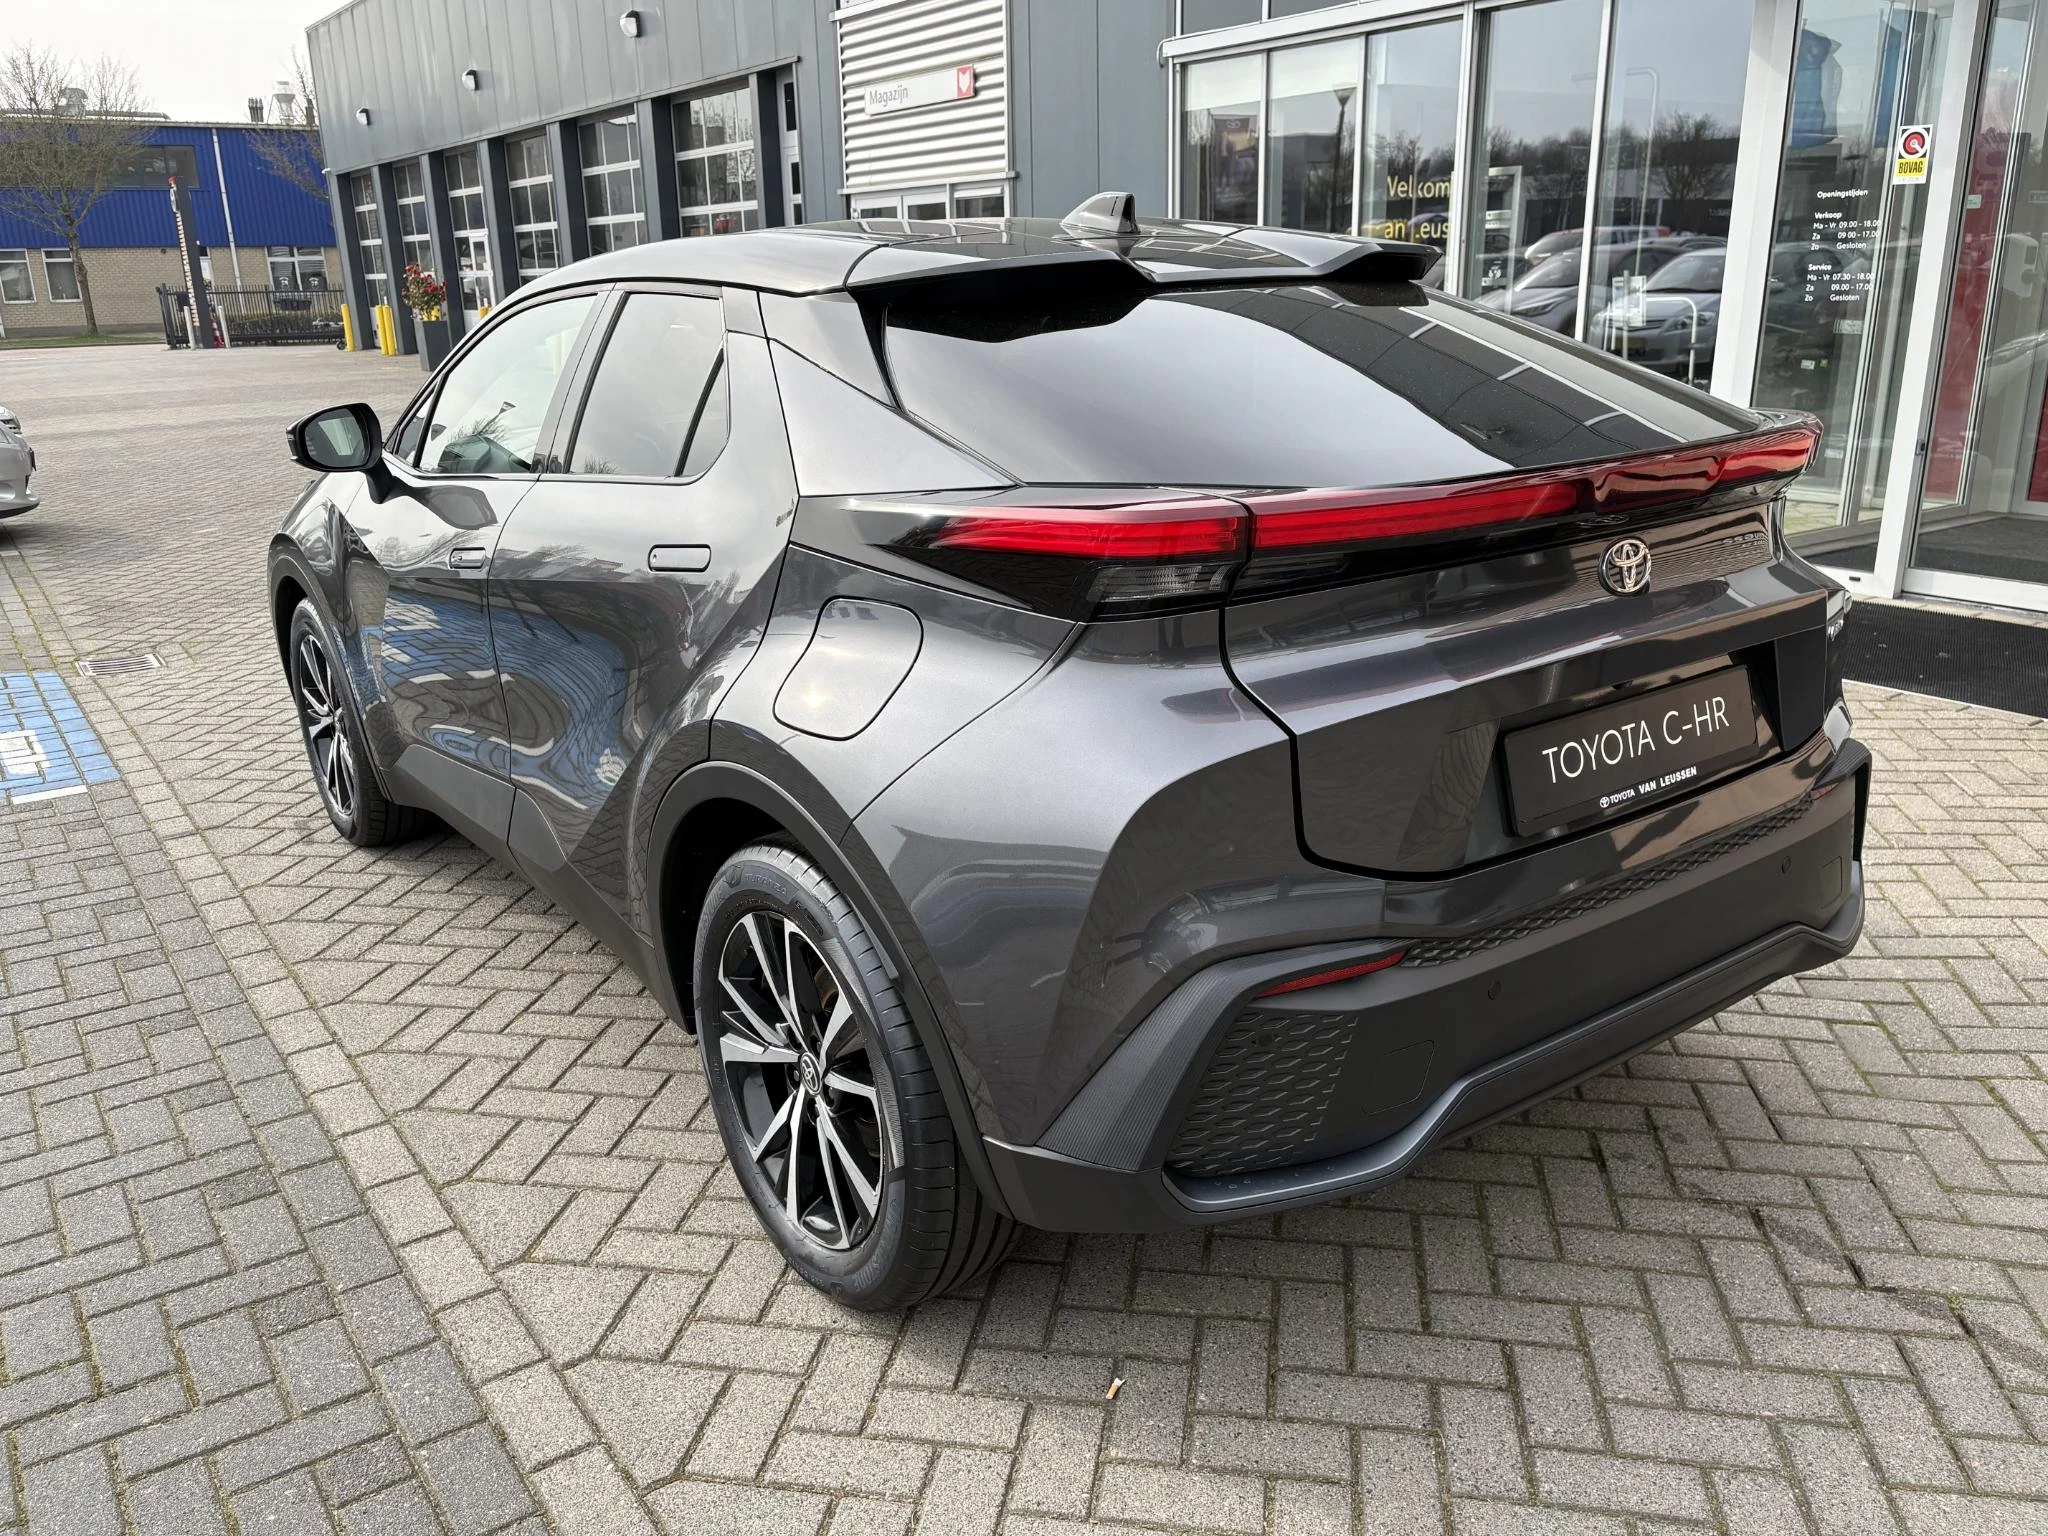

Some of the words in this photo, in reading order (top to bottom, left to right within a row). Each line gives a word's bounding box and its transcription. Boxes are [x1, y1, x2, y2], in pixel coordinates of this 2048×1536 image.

[869, 85, 908, 107] Magazijn
[1898, 160, 1924, 174] BOVAG
[1816, 189, 1868, 199] Openingstijden
[1814, 211, 1842, 220] Verkoop
[1813, 222, 1824, 230] Ma
[1839, 221, 1857, 229] 09.00
[1812, 232, 1820, 240] Za
[1837, 231, 1856, 239] 0900
[1808, 263, 1832, 271] Service
[1804, 294, 1813, 302] Zo
[1830, 293, 1860, 301] Gesloten
[1542, 720, 1655, 783] TOYOTA
[1662, 696, 1730, 745] C-HR
[1609, 788, 1636, 804] TOYOTA
[1638, 780, 1657, 794] VAN
[1659, 765, 1697, 787] LEUSSEN
